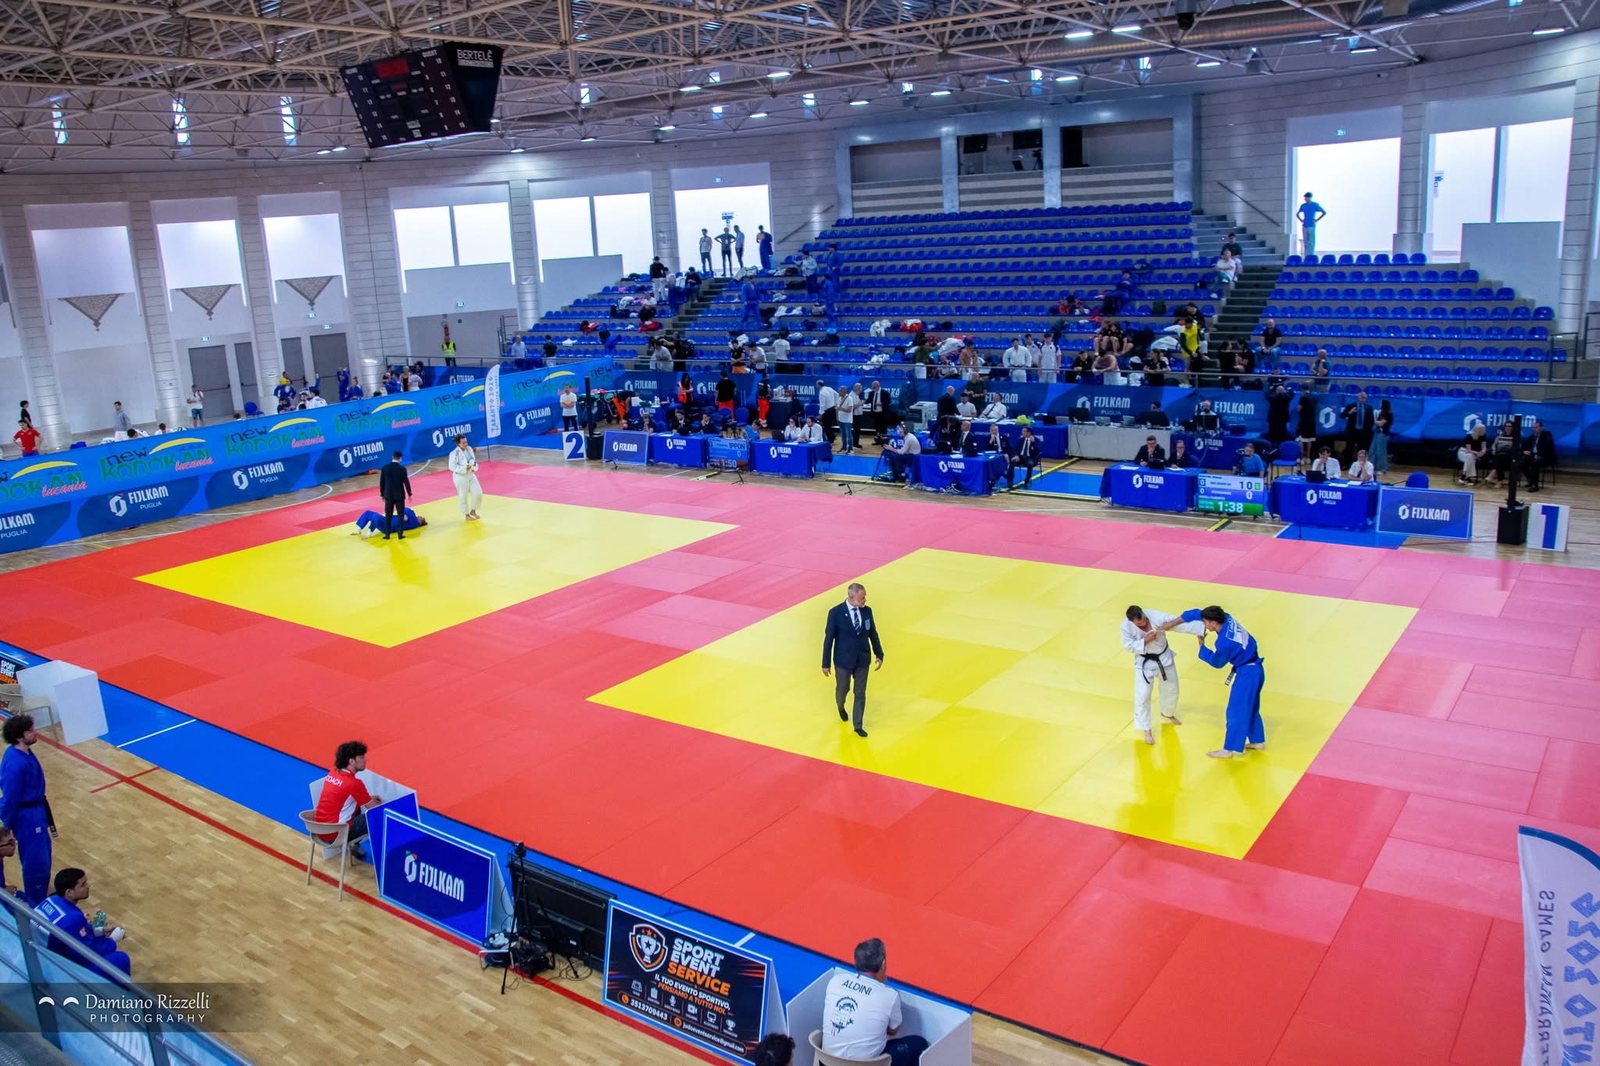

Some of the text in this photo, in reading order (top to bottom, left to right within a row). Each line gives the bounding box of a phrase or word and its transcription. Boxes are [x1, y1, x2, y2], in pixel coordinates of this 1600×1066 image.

[1094, 396, 1131, 408] FIJLKAM
[1214, 401, 1254, 415] FIJLKAM
[338, 406, 370, 423] new
[526, 407, 551, 420] FIJLKAM
[231, 426, 268, 443] new
[445, 424, 472, 437] FIJLKAM
[353, 441, 384, 457] FIJLKAM
[566, 433, 584, 460] 2
[105, 447, 148, 465] new
[247, 461, 285, 478] FIJLKAM
[128, 486, 169, 504] FIJLKAM
[140, 501, 162, 510] PUGLIA
[1218, 502, 1244, 513] 1:38
[1411, 507, 1450, 521] FIJLKAM
[1540, 505, 1559, 550] 1
[419, 862, 465, 902] FIJLKAM
[672, 937, 724, 964] SPORT
[670, 951, 720, 978] EVENT
[661, 976, 674, 988] TUO
[674, 981, 699, 997] EVENTO
[667, 961, 731, 996] SERVICE
[842, 979, 873, 996] ALDINI
